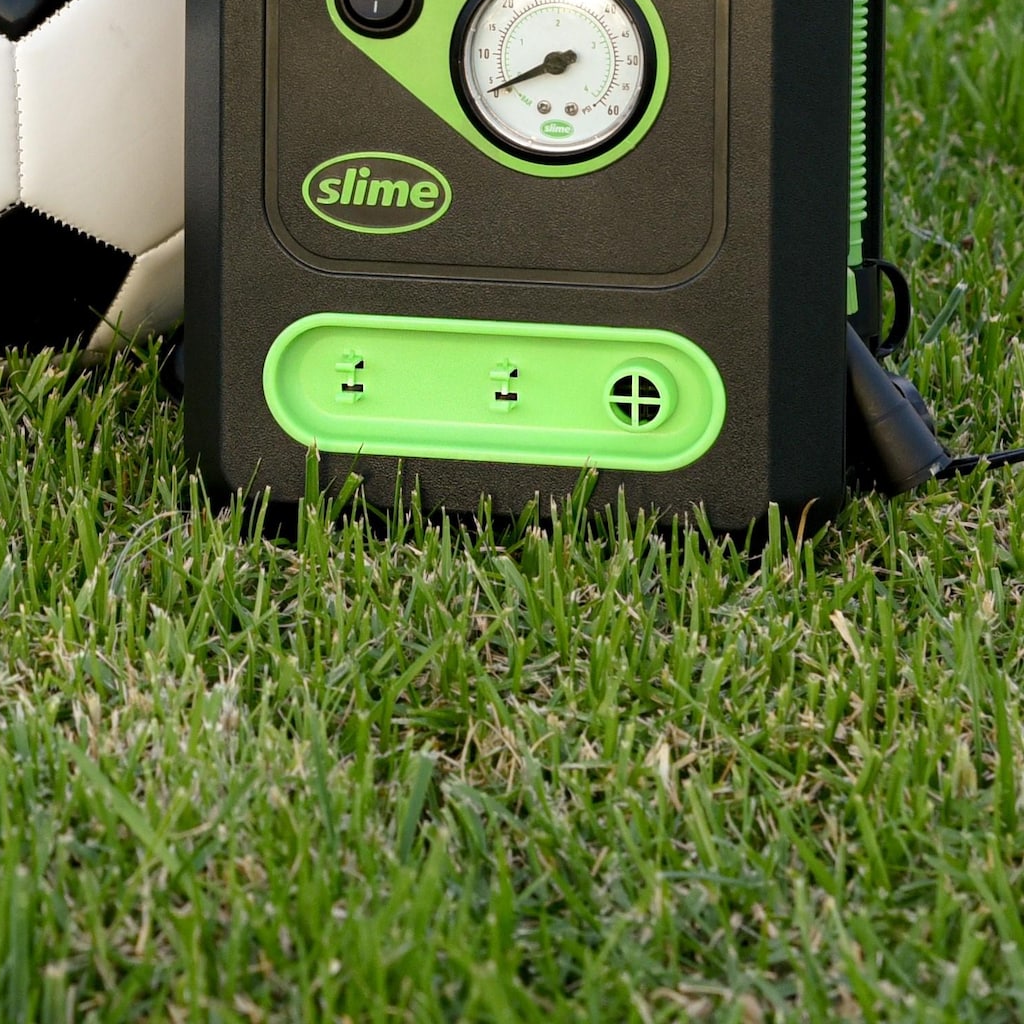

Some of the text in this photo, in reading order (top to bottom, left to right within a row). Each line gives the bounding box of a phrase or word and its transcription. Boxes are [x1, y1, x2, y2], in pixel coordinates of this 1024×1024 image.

[605, 2, 617, 15] 40
[488, 23, 496, 32] 15
[555, 19, 561, 27] 2
[621, 29, 630, 38] 45
[591, 41, 596, 49] 3
[478, 48, 490, 59] 10
[626, 54, 639, 66] 50
[488, 76, 494, 85] 5
[583, 84, 589, 92] 4
[621, 82, 630, 91] 55
[581, 104, 593, 115] PSI
[607, 104, 619, 116] 60
[544, 123, 571, 134] slime
[316, 166, 440, 209] slime
